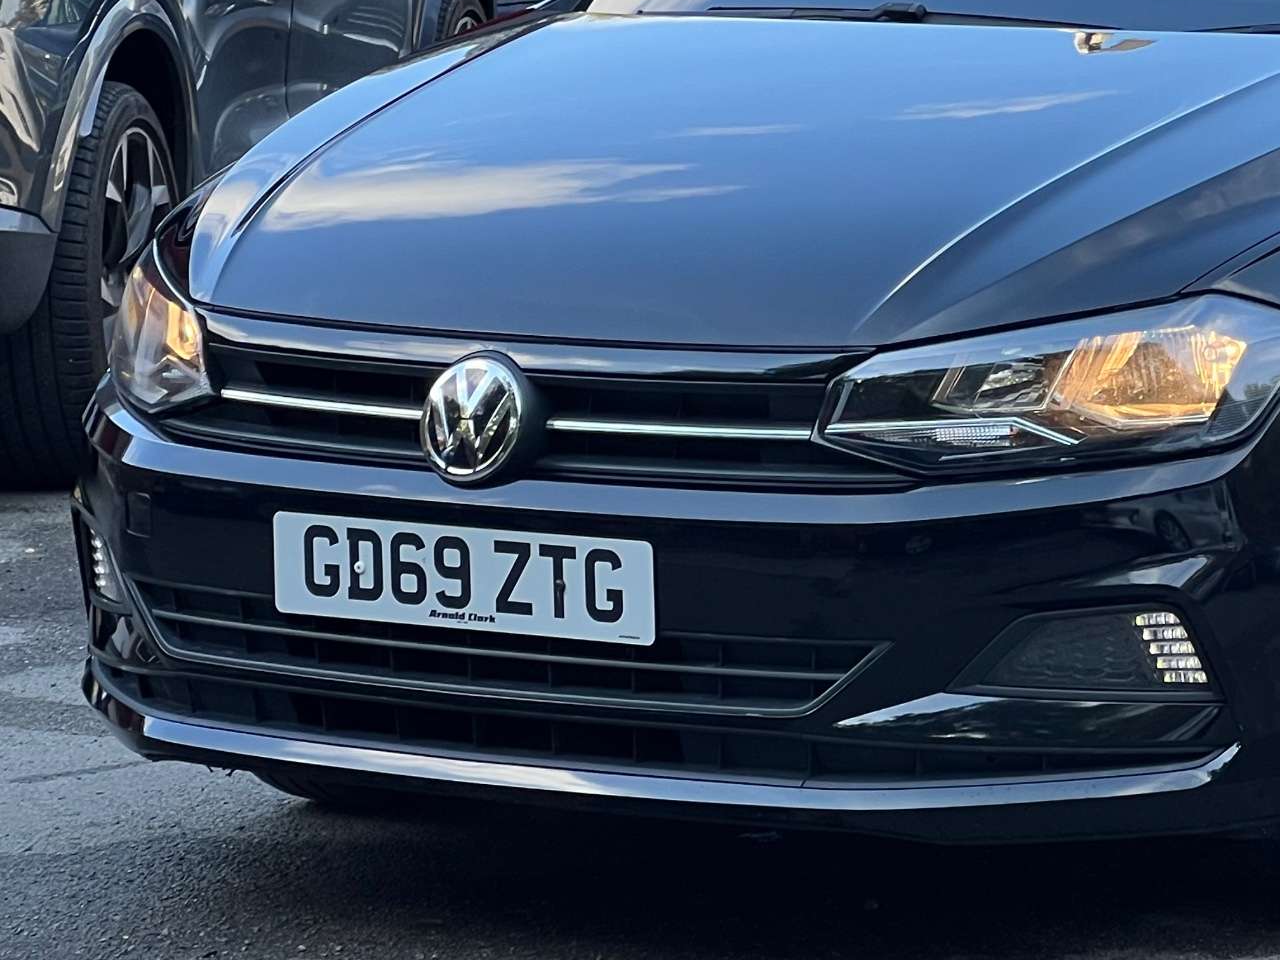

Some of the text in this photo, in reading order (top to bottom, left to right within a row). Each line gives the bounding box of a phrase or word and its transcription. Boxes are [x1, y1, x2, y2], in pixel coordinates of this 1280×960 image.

[303, 524, 625, 623] GD69 ZTG
[429, 609, 496, 623] Arnold Clark
